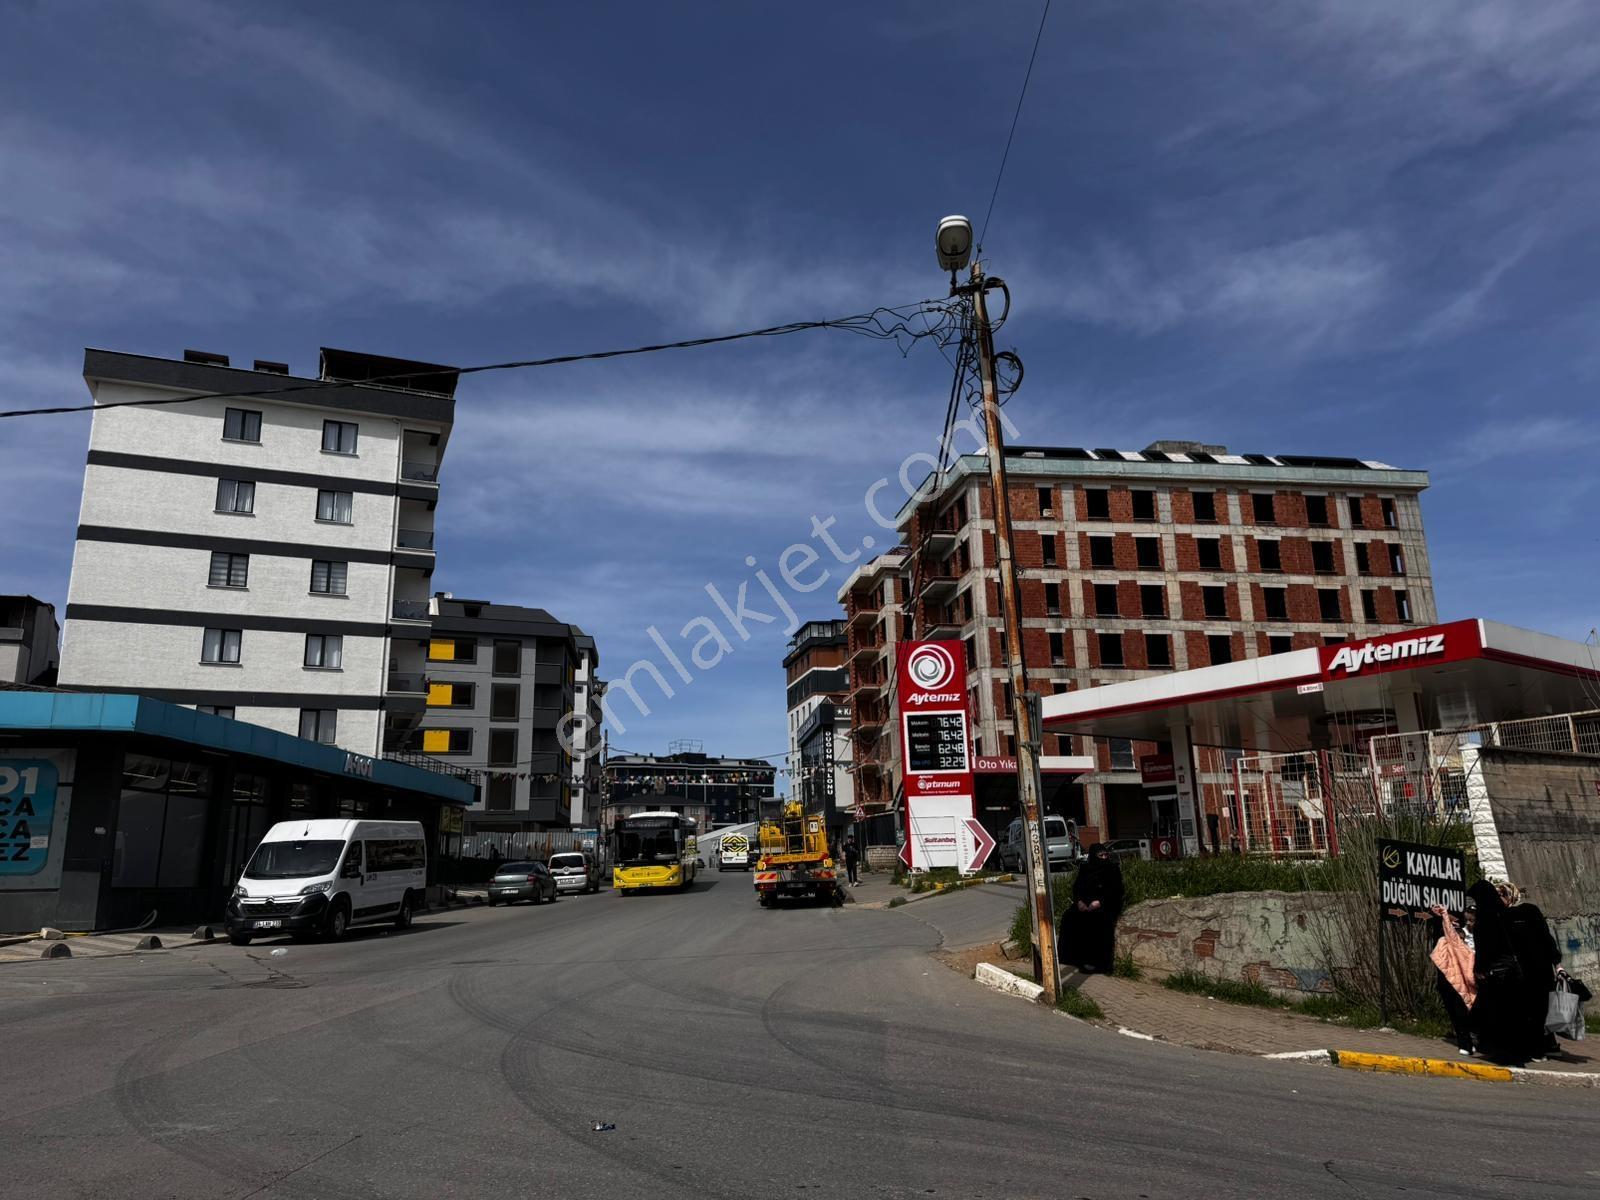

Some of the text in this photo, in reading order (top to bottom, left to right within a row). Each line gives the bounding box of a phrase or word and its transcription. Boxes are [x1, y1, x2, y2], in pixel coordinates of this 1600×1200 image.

[1327, 634, 1445, 673] Aytemiz
[907, 692, 961, 705] Aytemiz
[978, 760, 997, 769] Oto
[1406, 851, 1462, 881] KAYALAR
[1383, 877, 1464, 913] DÜĞÜN SALONU
